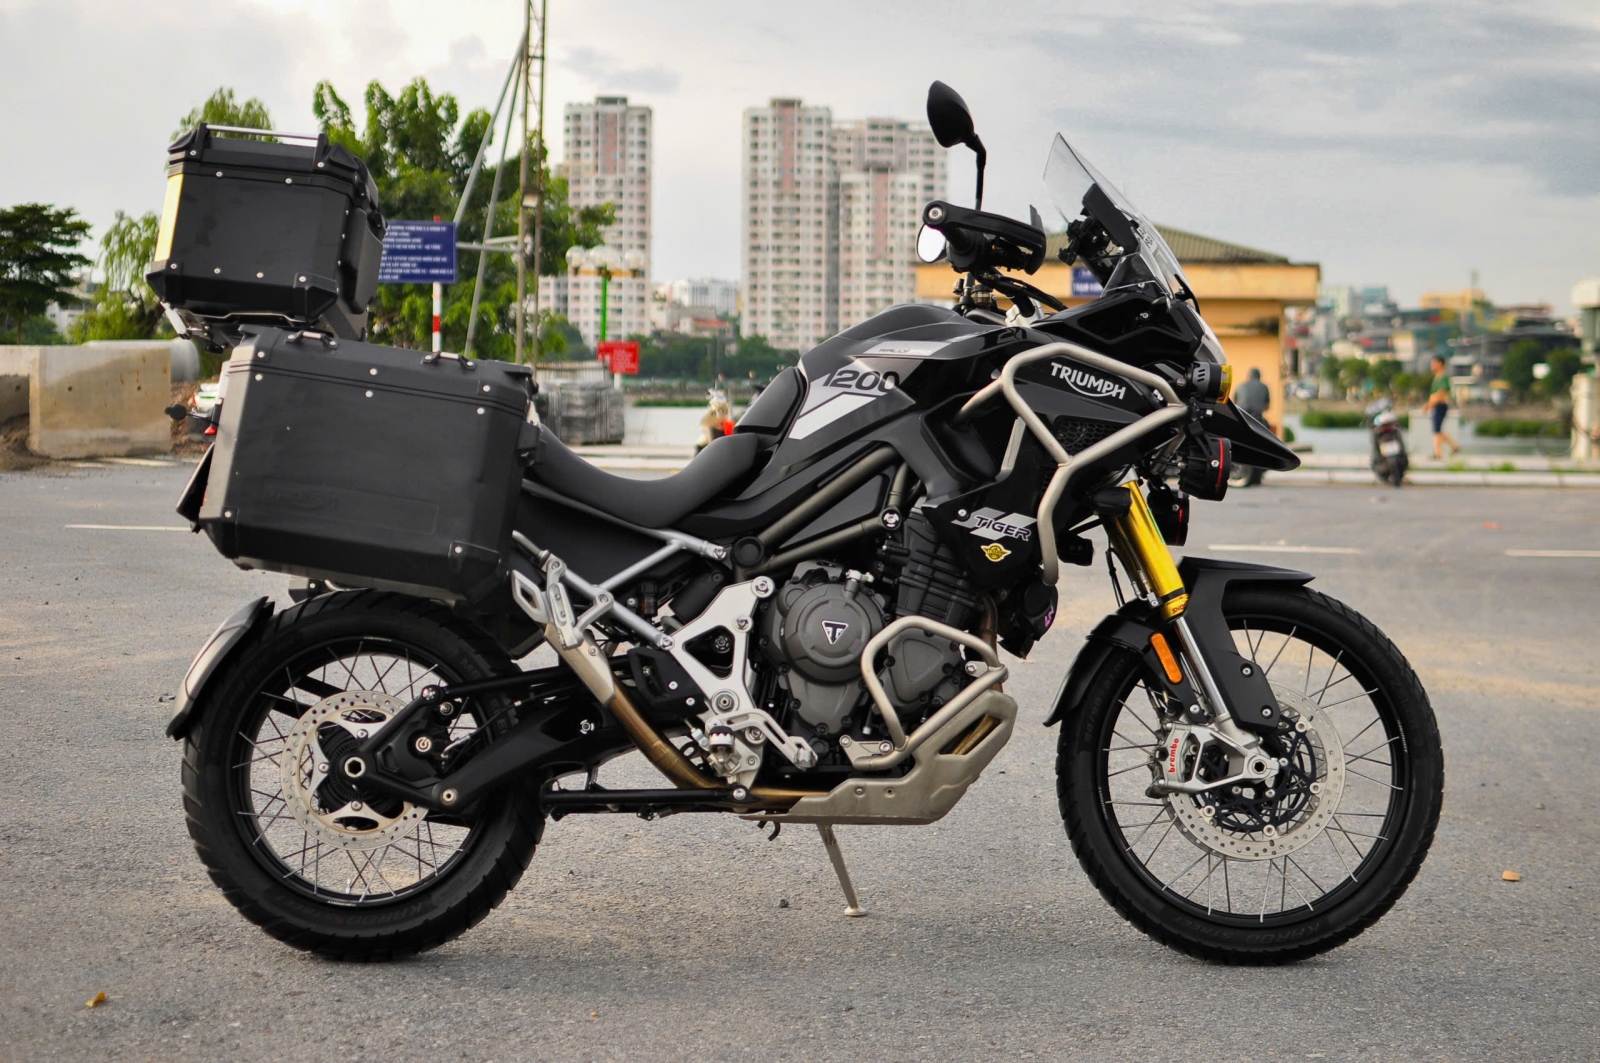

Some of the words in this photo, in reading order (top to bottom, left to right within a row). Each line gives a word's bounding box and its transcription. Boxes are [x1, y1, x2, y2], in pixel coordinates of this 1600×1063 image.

[823, 370, 900, 392] 1200
[1051, 362, 1126, 400] TRIUMPH
[974, 515, 1031, 542] TIGER
[1168, 738, 1180, 773] brembo
[1176, 917, 1234, 939] STREET
[1245, 922, 1320, 944] KAROO
